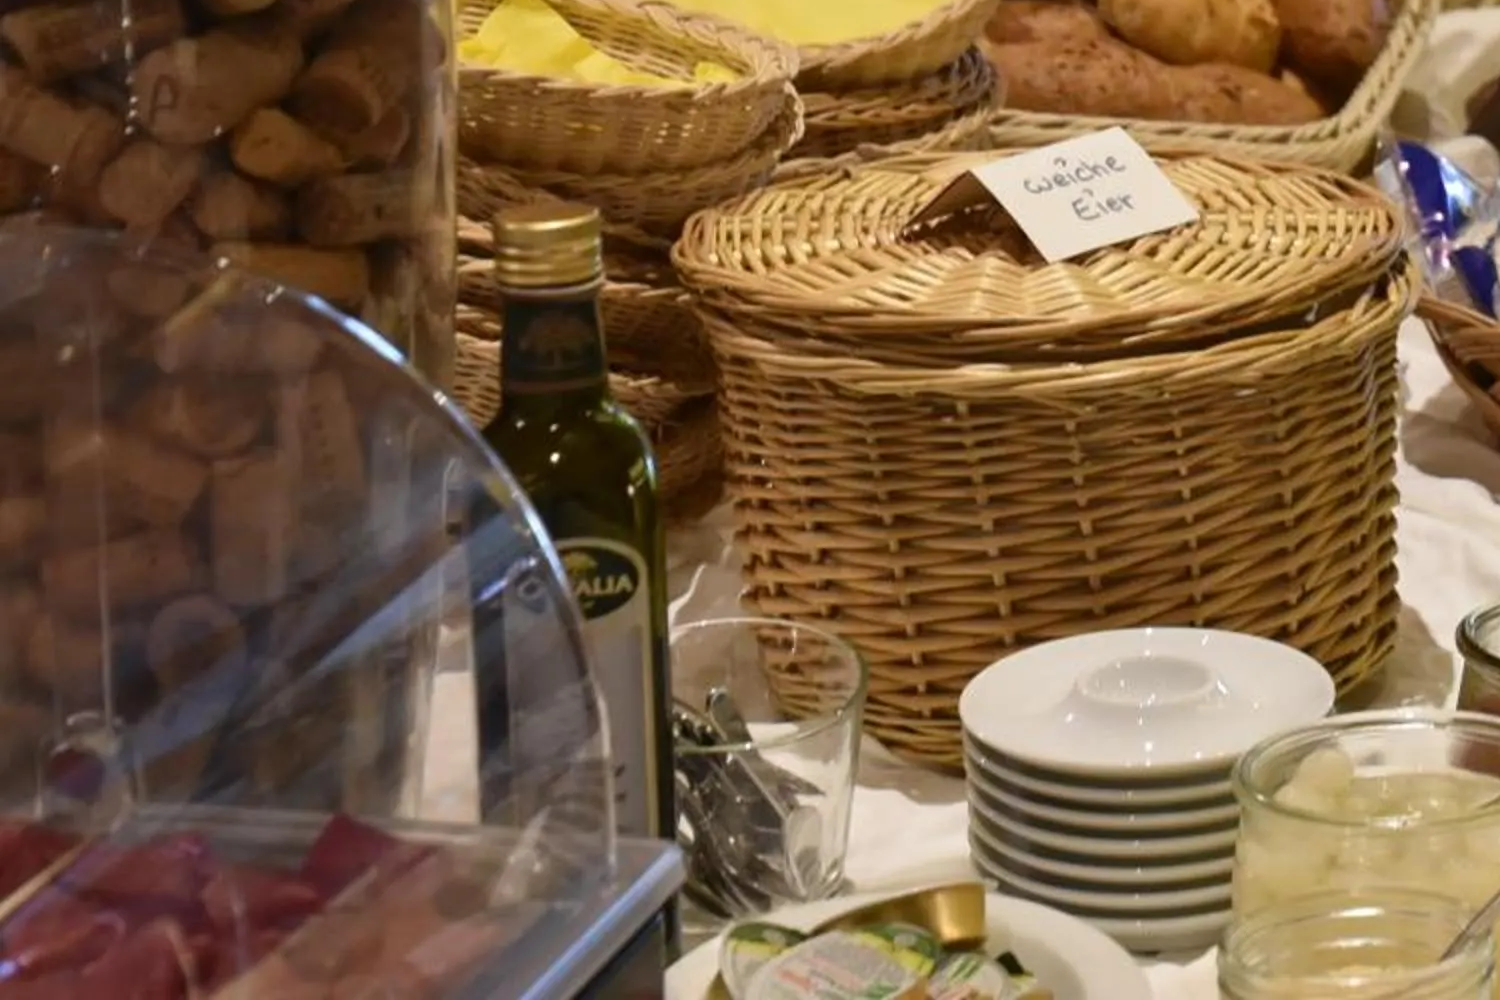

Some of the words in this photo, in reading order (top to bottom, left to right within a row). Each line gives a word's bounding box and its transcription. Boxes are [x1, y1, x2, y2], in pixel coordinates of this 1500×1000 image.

[1023, 154, 1127, 196] weiche
[1071, 188, 1136, 222] Eier
[573, 572, 634, 598] ALIA
